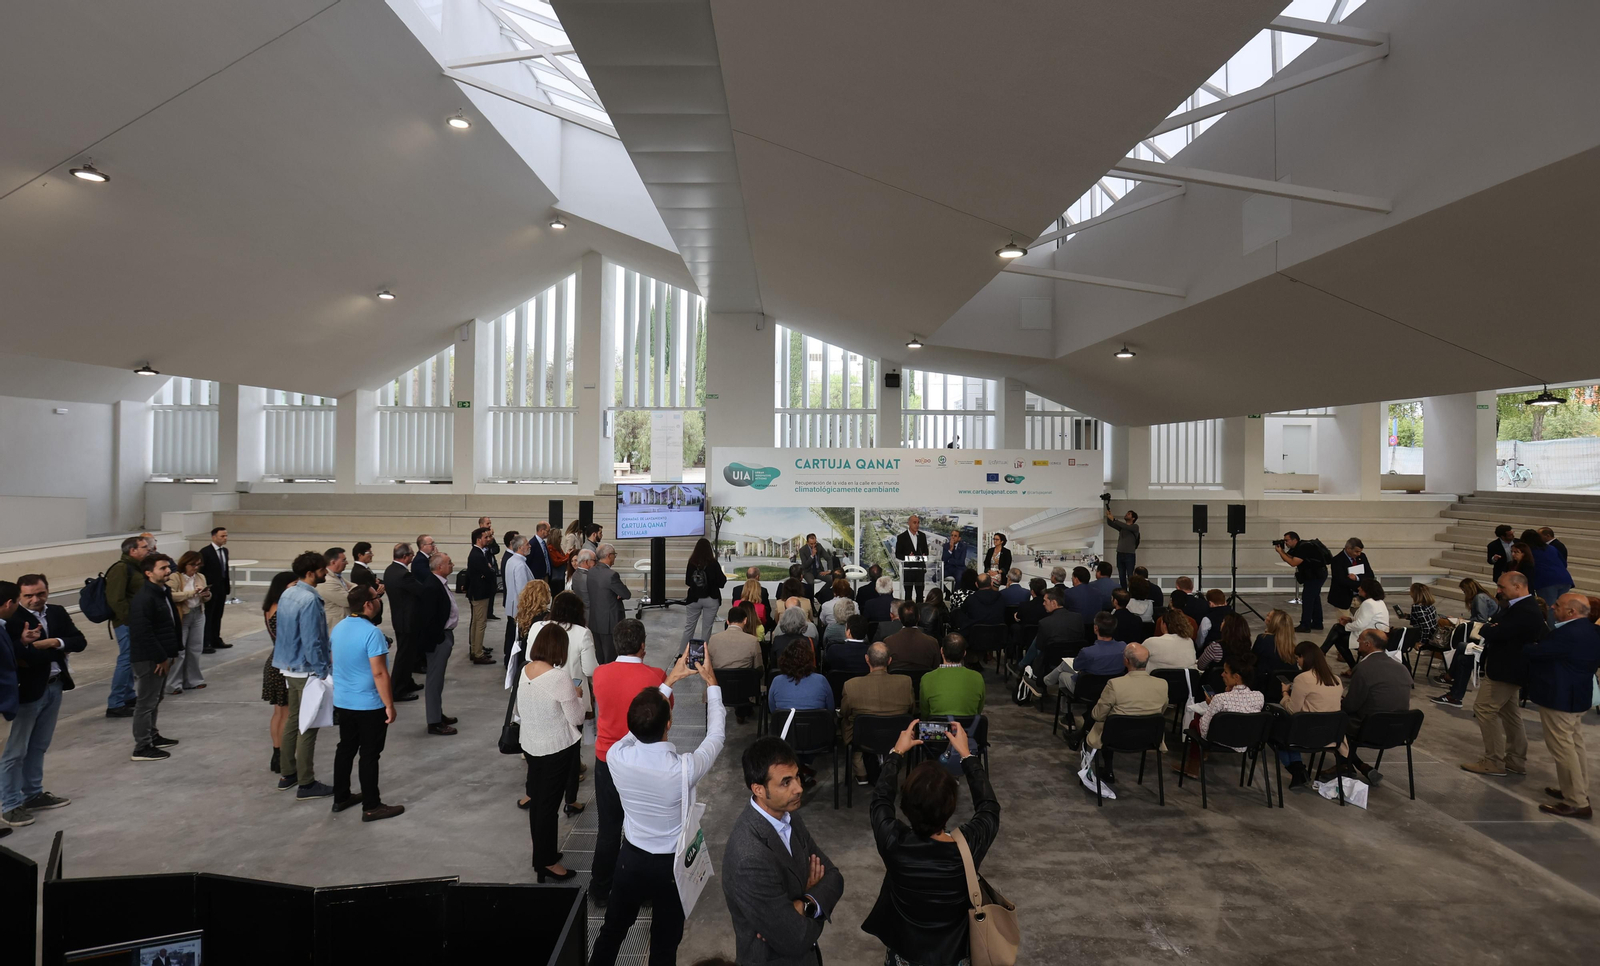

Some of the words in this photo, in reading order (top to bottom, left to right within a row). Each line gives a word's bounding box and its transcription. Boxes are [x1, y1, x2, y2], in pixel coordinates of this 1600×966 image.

[795, 458, 851, 469] CARTUJA
[856, 458, 901, 469] QANAT
[732, 471, 751, 480] UIA
[795, 486, 862, 494] climatológicamente
[687, 847, 696, 862] UIA
